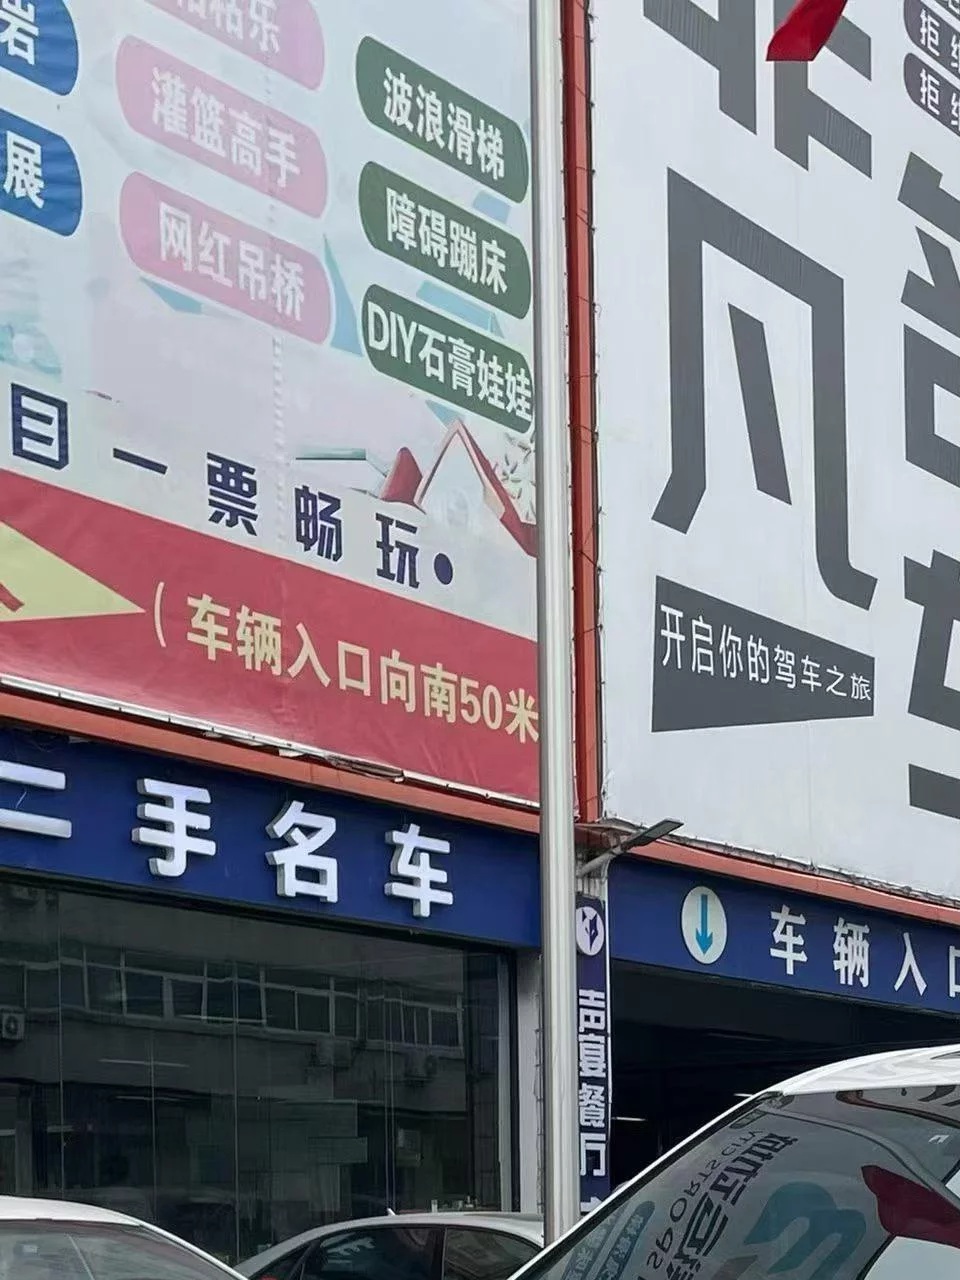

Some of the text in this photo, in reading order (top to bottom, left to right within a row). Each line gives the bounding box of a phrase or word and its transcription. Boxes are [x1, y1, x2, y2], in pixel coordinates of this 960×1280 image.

[151, 66, 299, 188] 灌篮高手
[383, 66, 505, 181] 波浪滑梯
[158, 200, 304, 320] 网红吊桥
[386, 185, 508, 296] 障碍蹦床
[367, 300, 533, 422] DIY石膏娃娃
[660, 604, 872, 701] 开启你的驾车之旅
[0, 760, 454, 918] 二手名车
